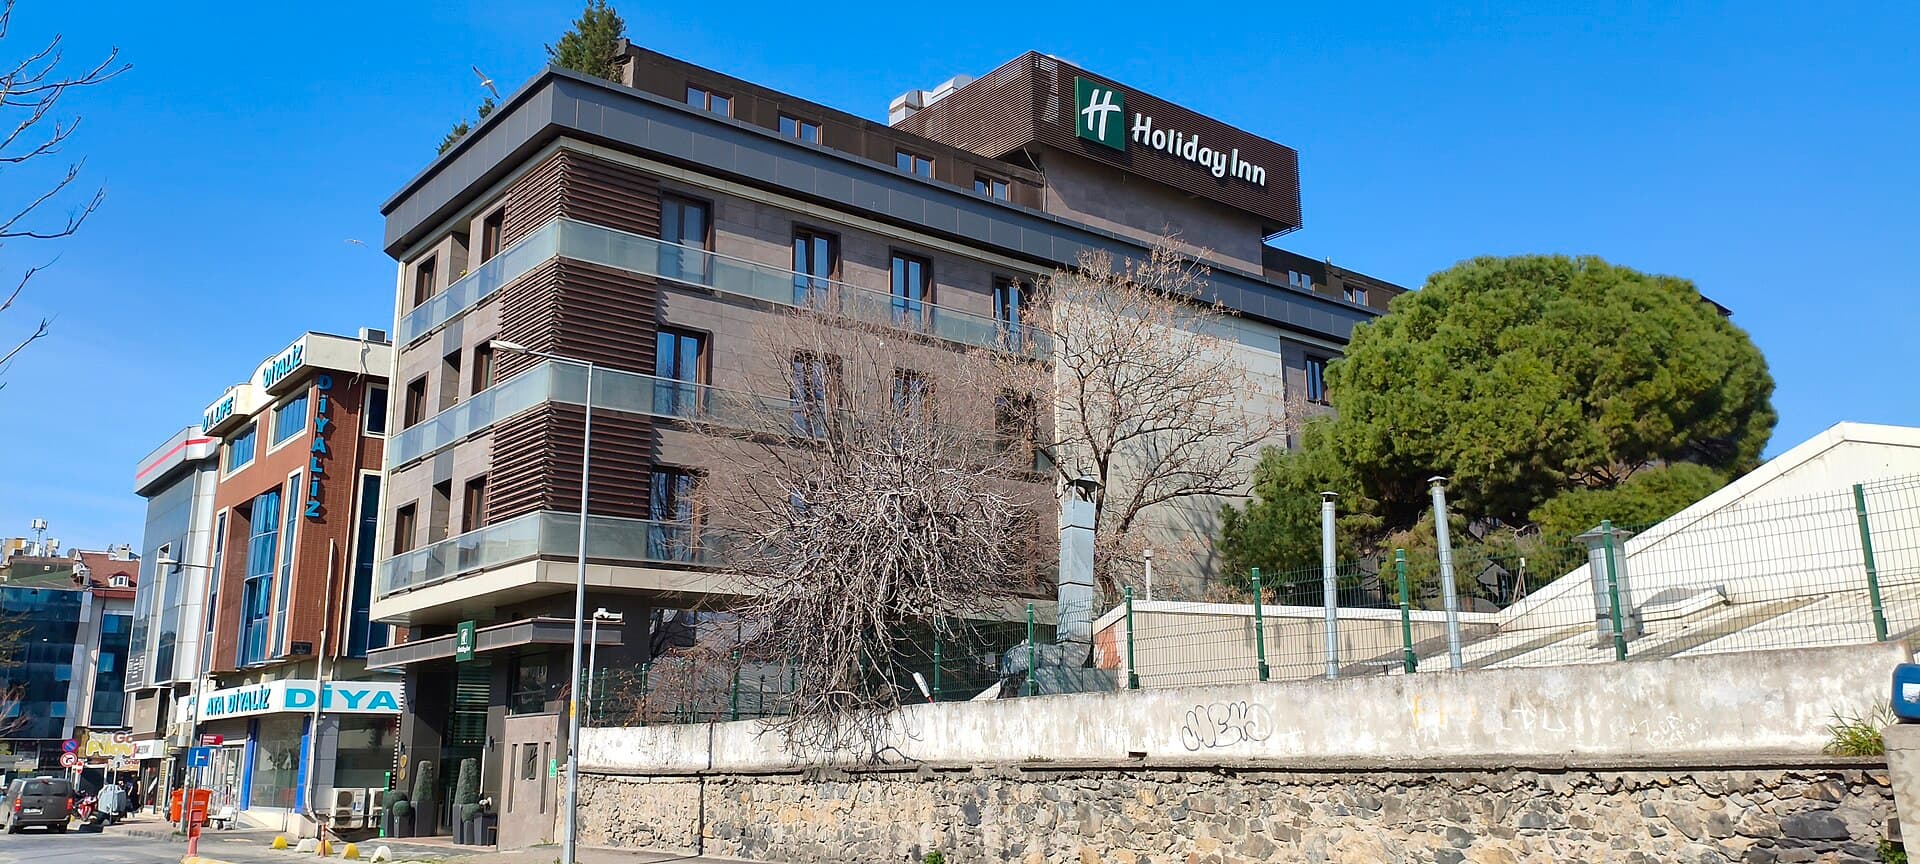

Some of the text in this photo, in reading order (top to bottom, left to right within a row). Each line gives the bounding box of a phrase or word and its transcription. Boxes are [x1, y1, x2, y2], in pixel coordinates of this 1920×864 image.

[1131, 112, 1266, 187] Holiday Inn
[305, 374, 334, 517] DİYALİZ
[206, 696, 224, 716] ATA
[228, 685, 271, 713] DİYALİZ
